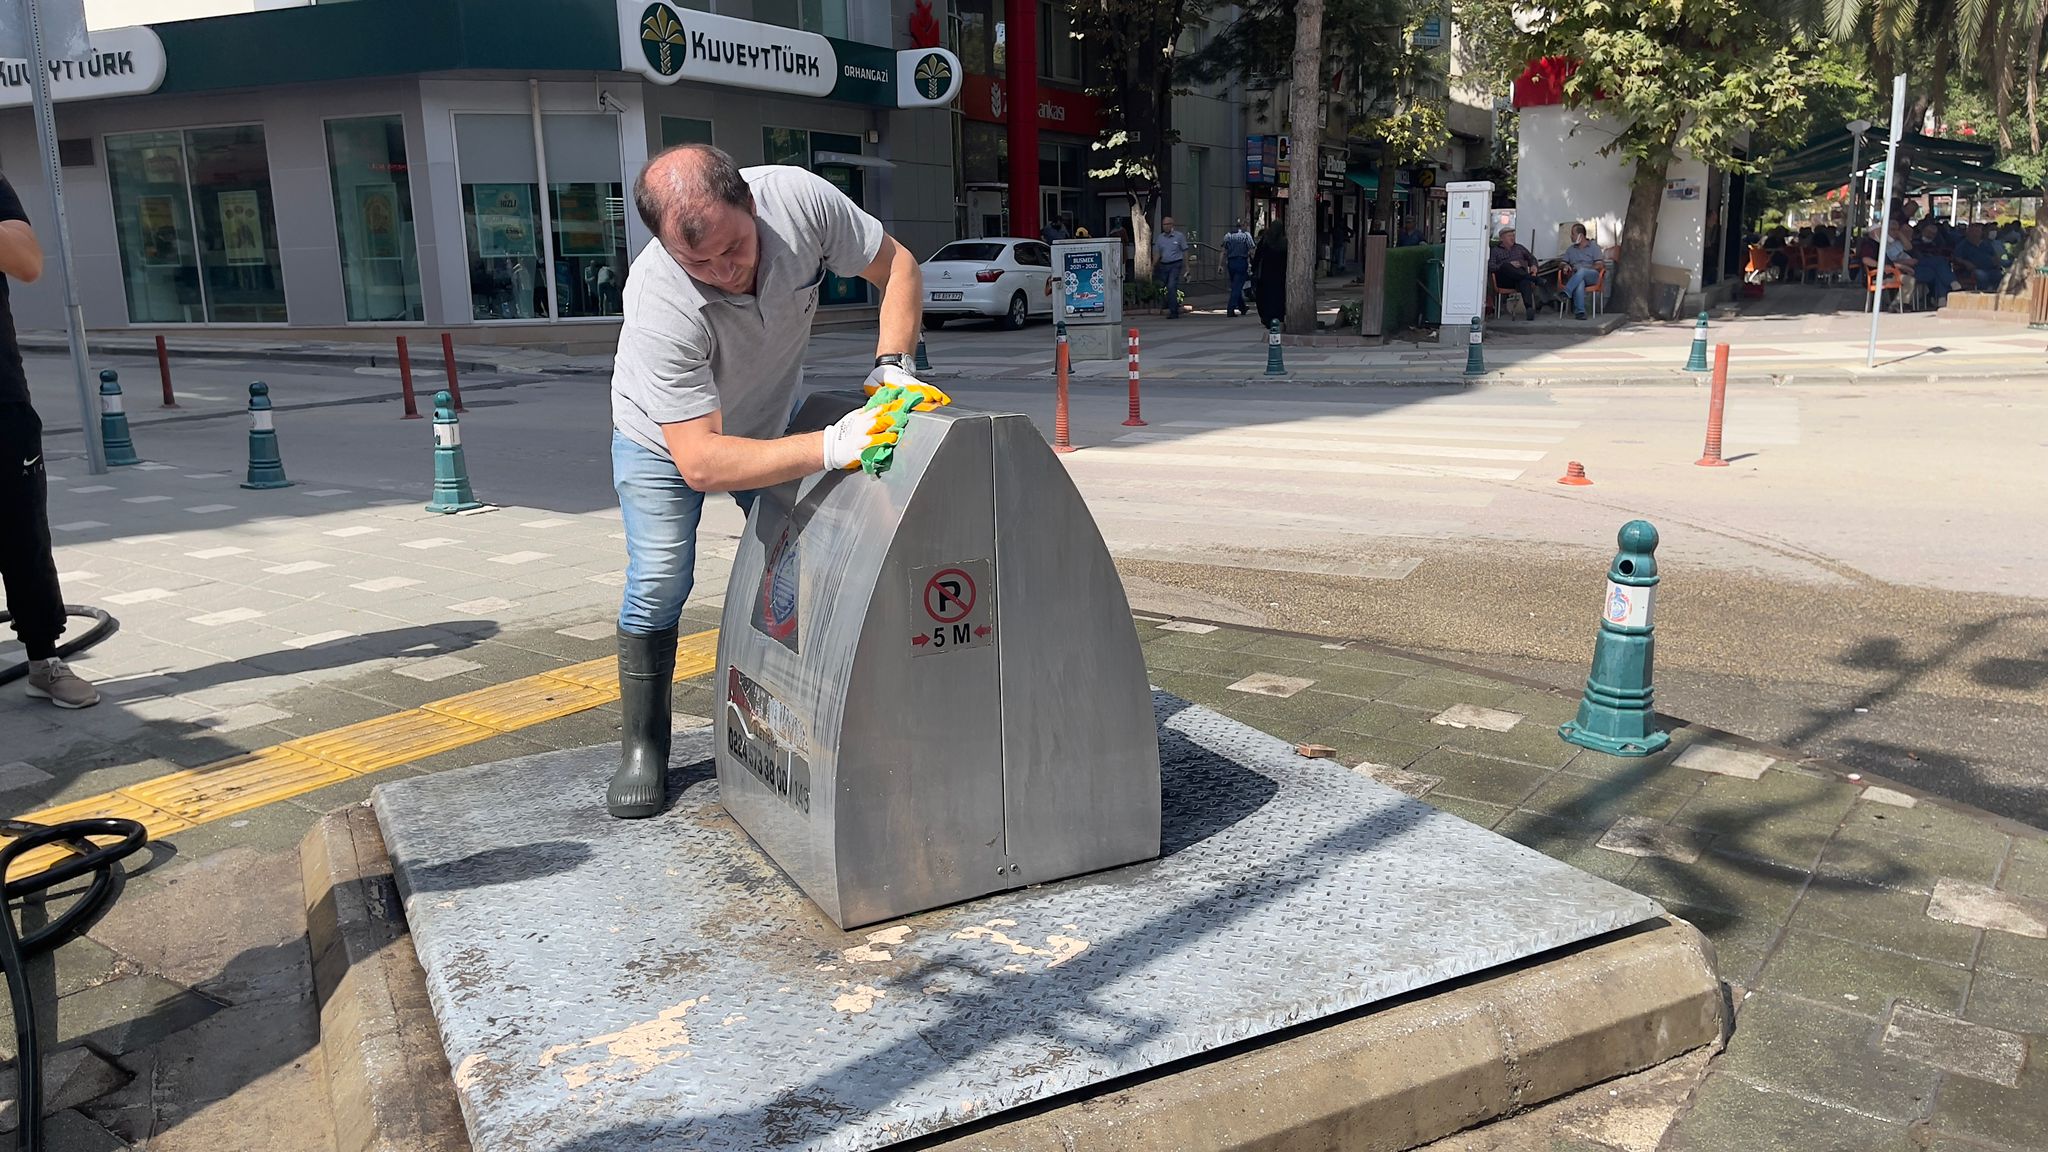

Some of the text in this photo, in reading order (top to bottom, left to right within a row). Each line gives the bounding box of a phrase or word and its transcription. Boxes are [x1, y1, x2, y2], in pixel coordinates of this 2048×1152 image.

[844, 64, 889, 84] ORHANGAZİ
[938, 580, 962, 612] P
[933, 623, 971, 648] 5 M
[728, 727, 748, 763] 0224
[764, 755, 775, 786] 38
[776, 765, 788, 796] 00
